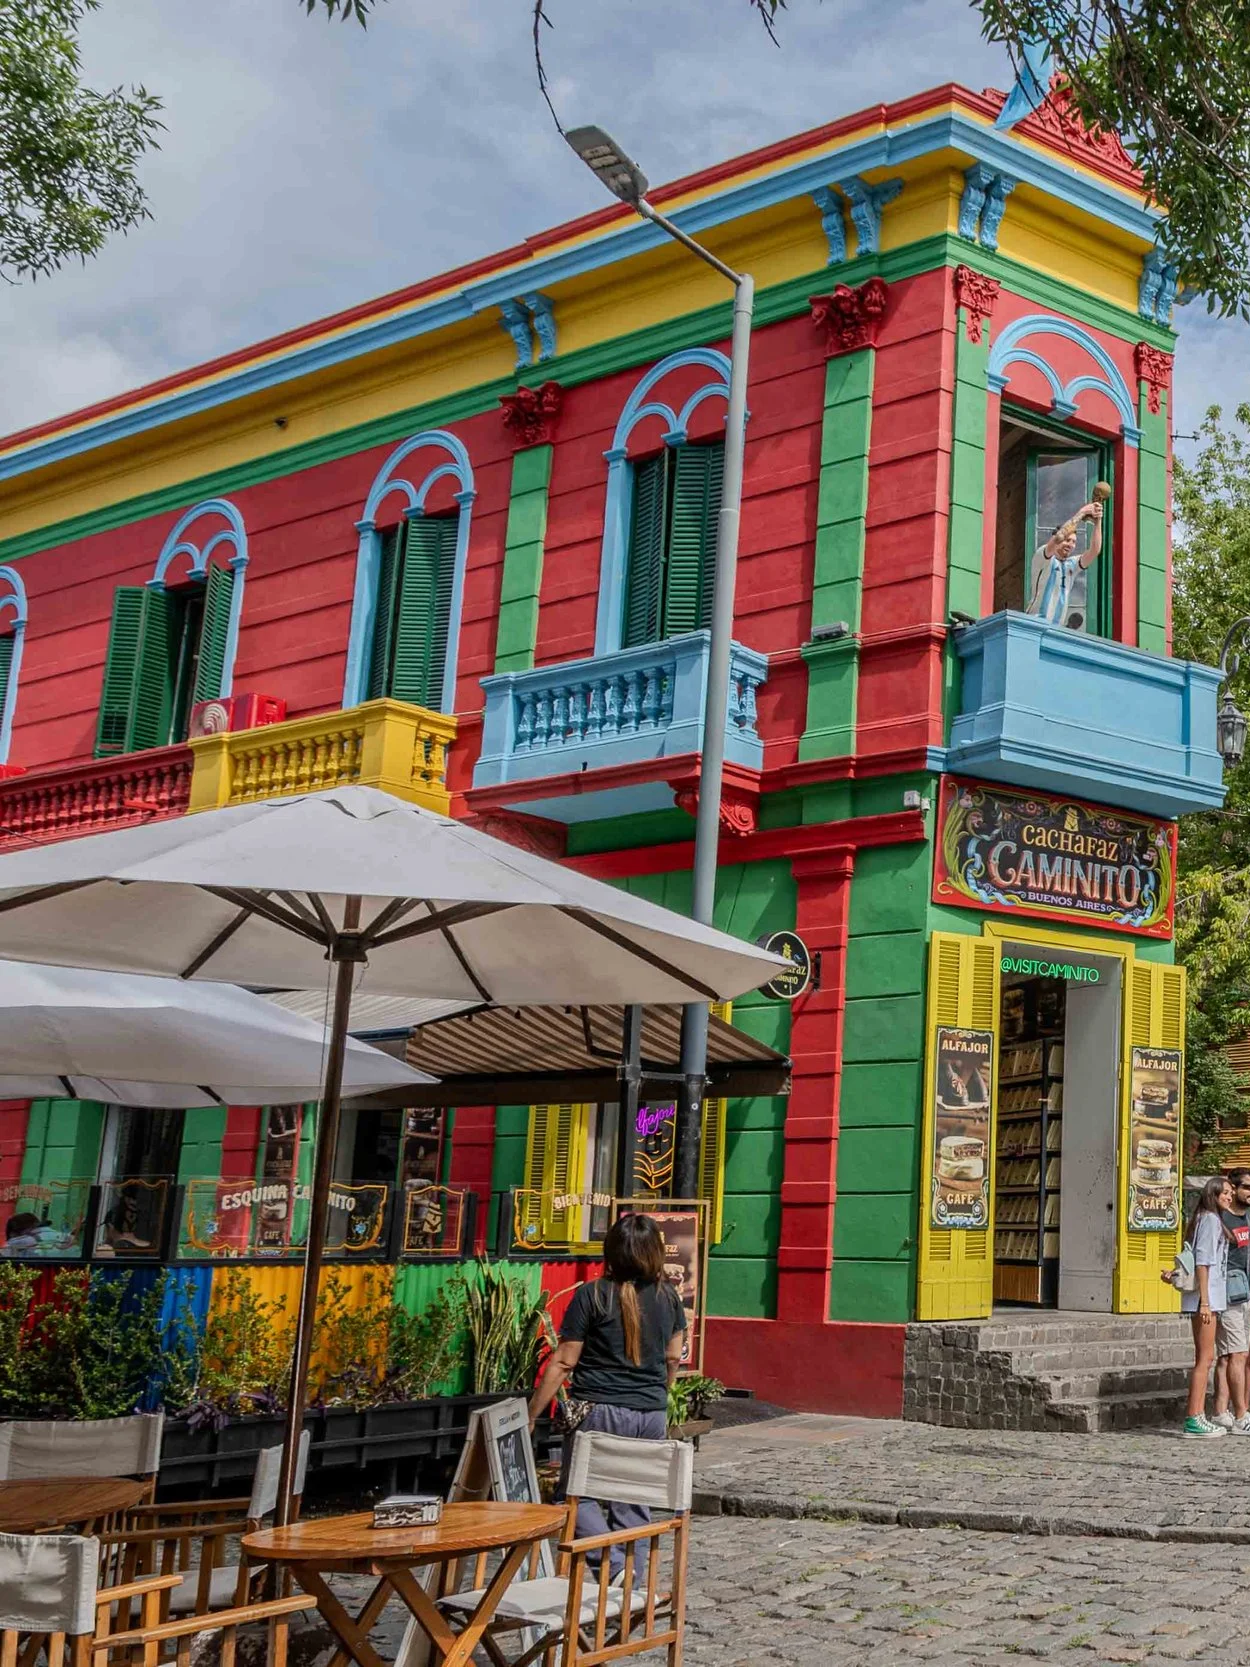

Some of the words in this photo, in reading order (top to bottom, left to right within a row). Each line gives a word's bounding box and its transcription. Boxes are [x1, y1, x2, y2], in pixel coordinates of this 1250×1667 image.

[987, 840, 1142, 908] CAMINITO
[1028, 892, 1072, 906] BUENOS
[1075, 900, 1106, 912] AIRES
[1000, 956, 1100, 982] @VISITCAMINITO
[942, 1039, 989, 1054] ALFAJOR
[1135, 1057, 1178, 1071] ALFAJOR
[221, 1184, 288, 1210] ESQUINA
[292, 1184, 356, 1211] CANITO
